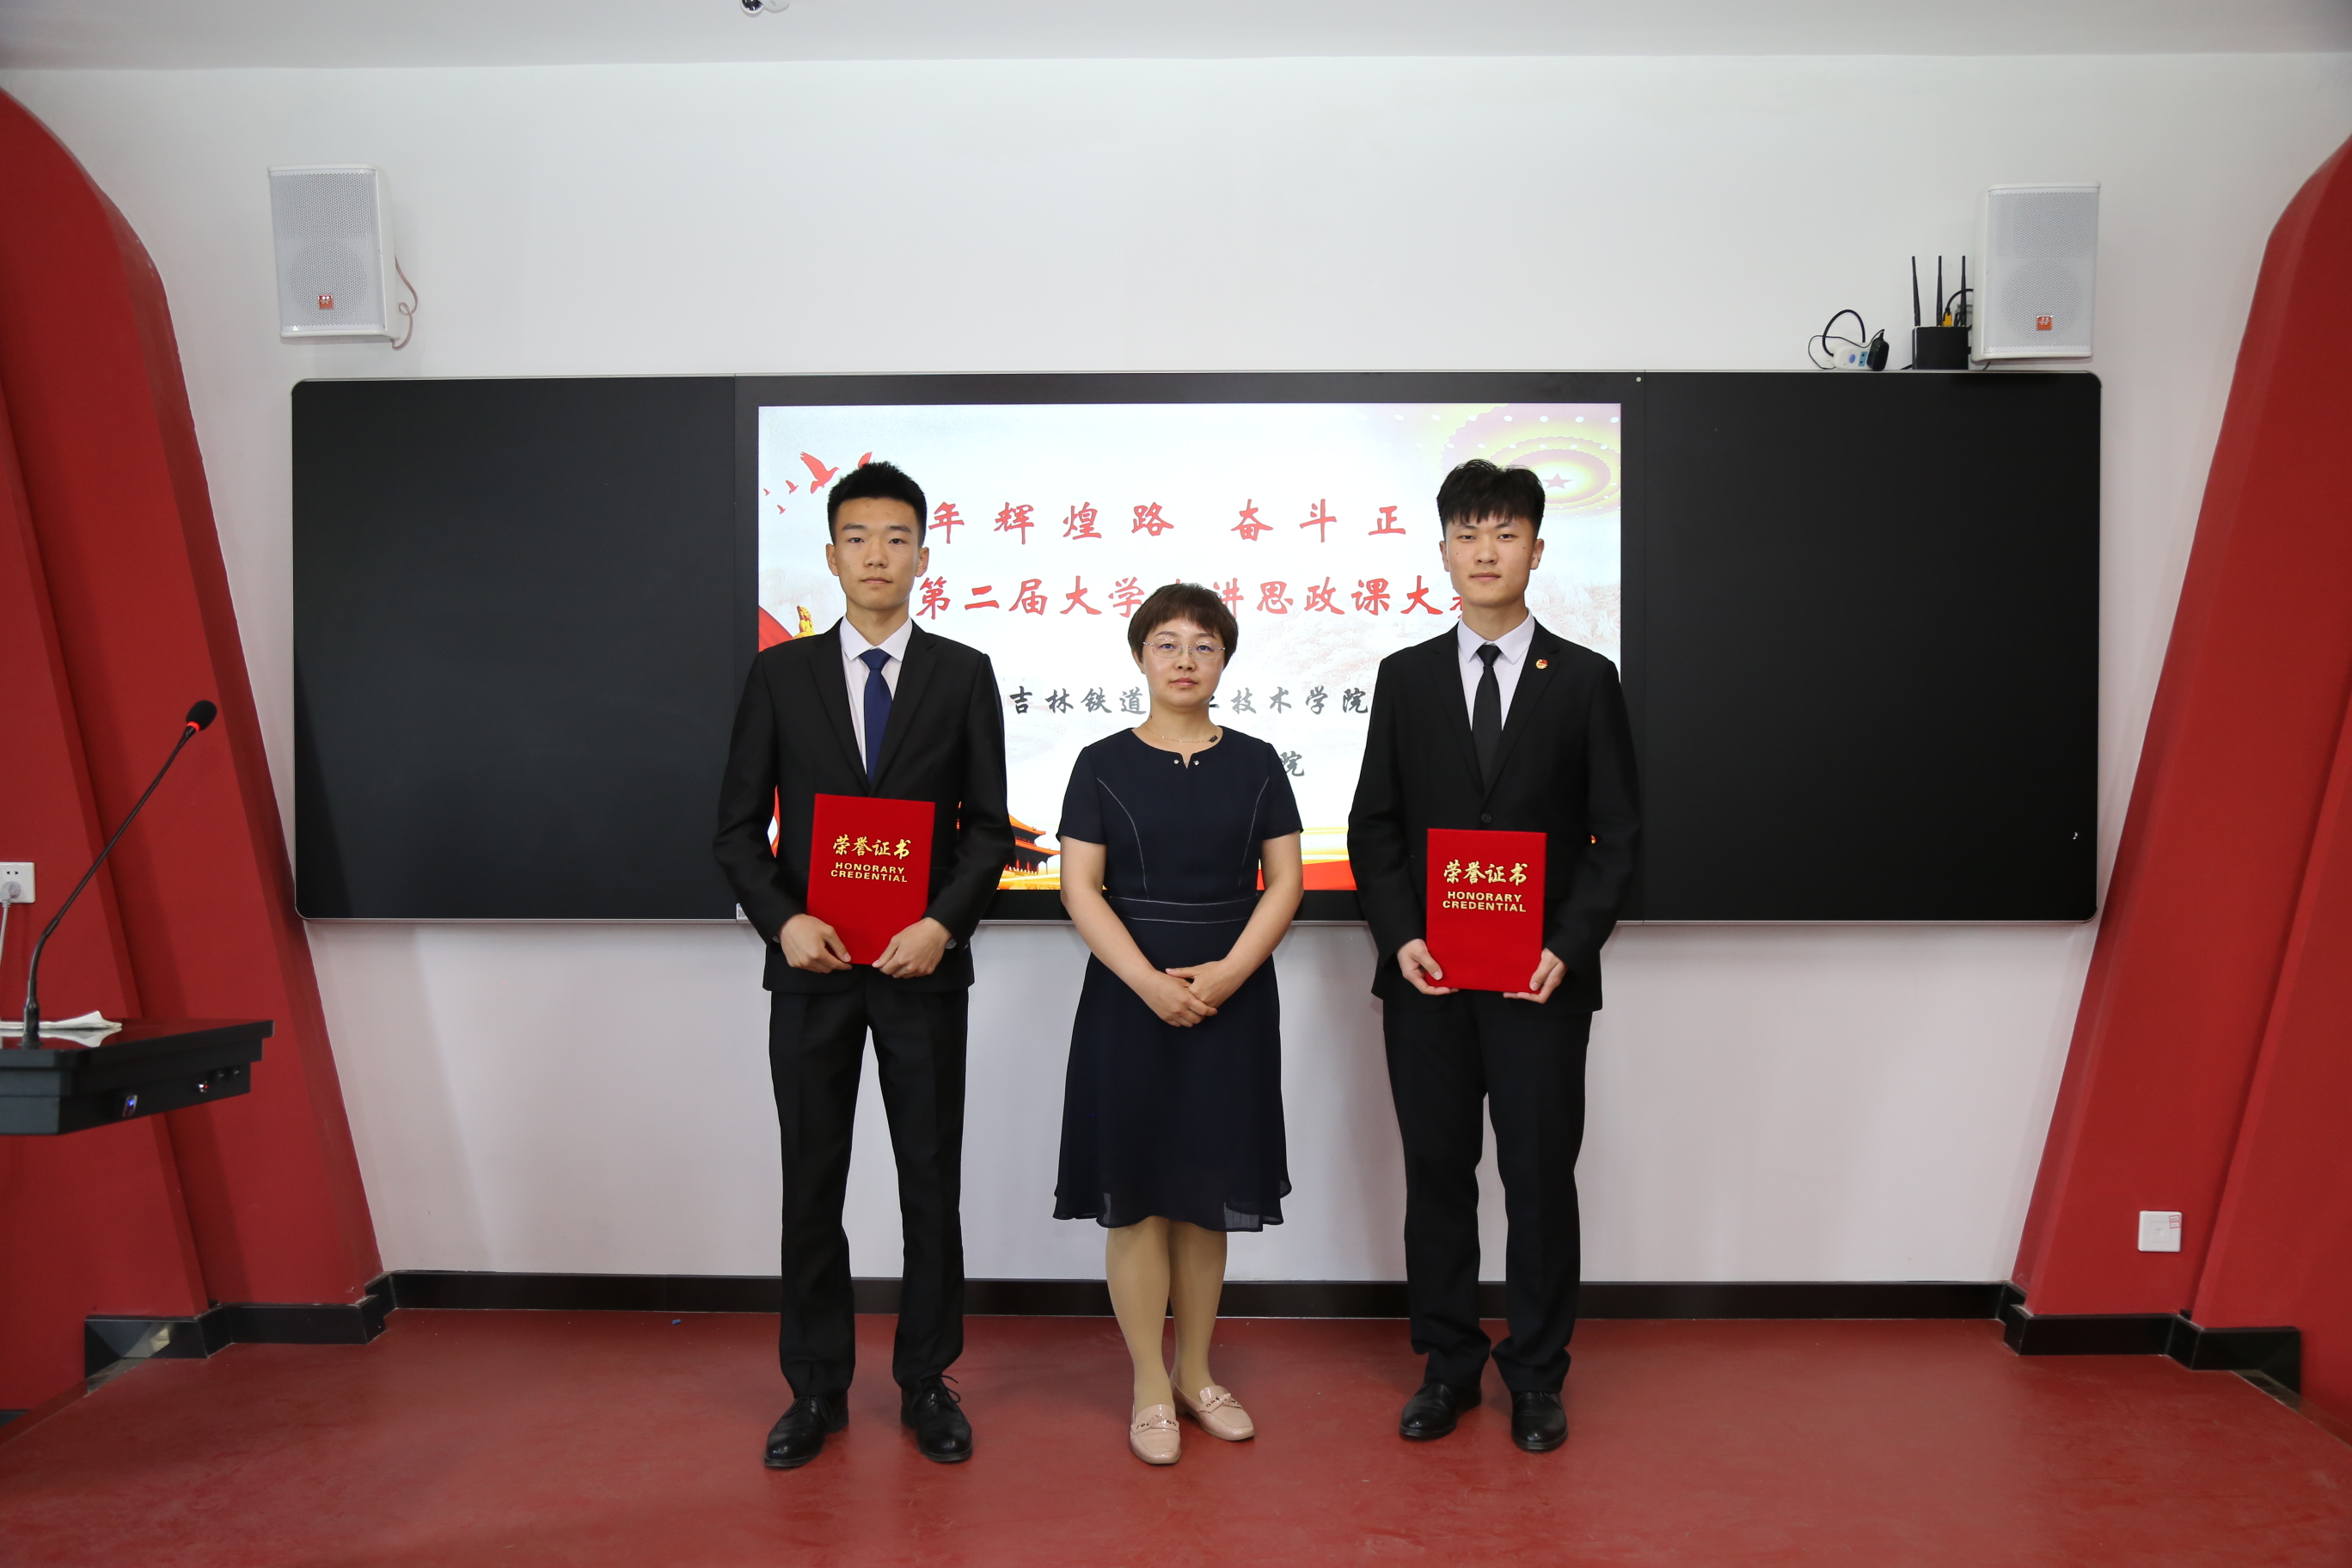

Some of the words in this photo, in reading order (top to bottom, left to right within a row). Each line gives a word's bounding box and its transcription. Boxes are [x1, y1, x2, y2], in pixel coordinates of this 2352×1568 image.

[1230, 499, 1406, 542] 奋斗正
[916, 575, 1463, 620] 第二届大学讲思政课大
[1009, 685, 1369, 715] 吉林铁道技术学院
[832, 834, 912, 860] 荣誉证书
[830, 870, 908, 883] CREDENTIAL
[835, 861, 905, 874] HONORARY
[1443, 859, 1528, 886] 荣誉证书
[1442, 900, 1527, 913] CREDENTIAL
[1447, 891, 1522, 903] HONORARY
